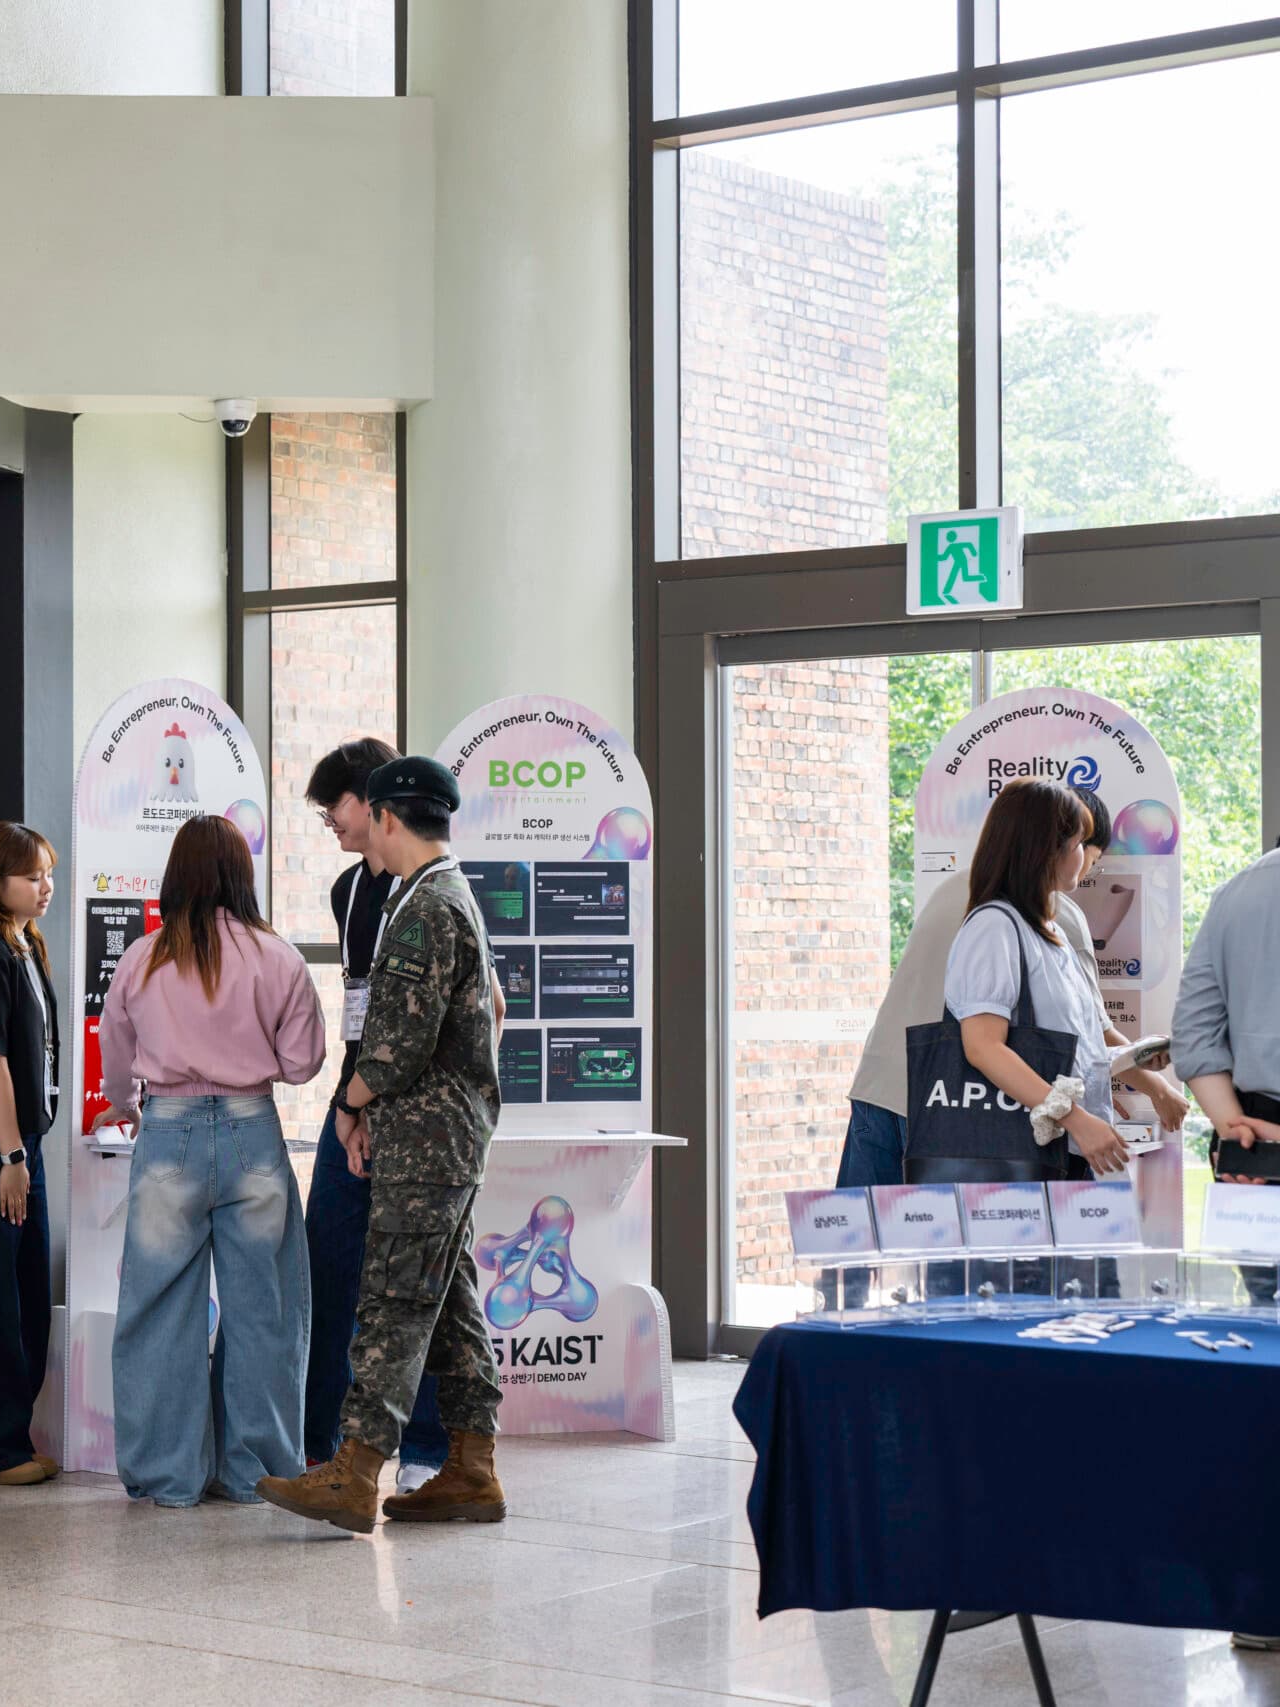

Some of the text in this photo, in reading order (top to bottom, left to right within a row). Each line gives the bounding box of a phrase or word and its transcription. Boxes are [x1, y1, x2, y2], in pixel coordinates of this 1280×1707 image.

[102, 697, 245, 774] Be Entrepreneur, Own The Future
[945, 703, 1145, 775] Be Entrepreneur, Own The Future
[451, 711, 624, 783] Be Entrepreneur, Own The Future
[489, 760, 586, 788] BCOP
[988, 756, 1068, 781] Reality
[522, 819, 553, 829] BCOP
[1098, 968, 1122, 976] obot
[1120, 1014, 1136, 1023] 의수
[903, 1211, 934, 1223] Aristo
[970, 1205, 1041, 1221] 르도드코퍼레이션
[1080, 1207, 1109, 1219] BCOP
[813, 1214, 848, 1229] 삼냥이즈
[492, 1335, 603, 1367] 5 KAIST
[498, 1371, 587, 1385] 25 상반기 DEMO DAY
